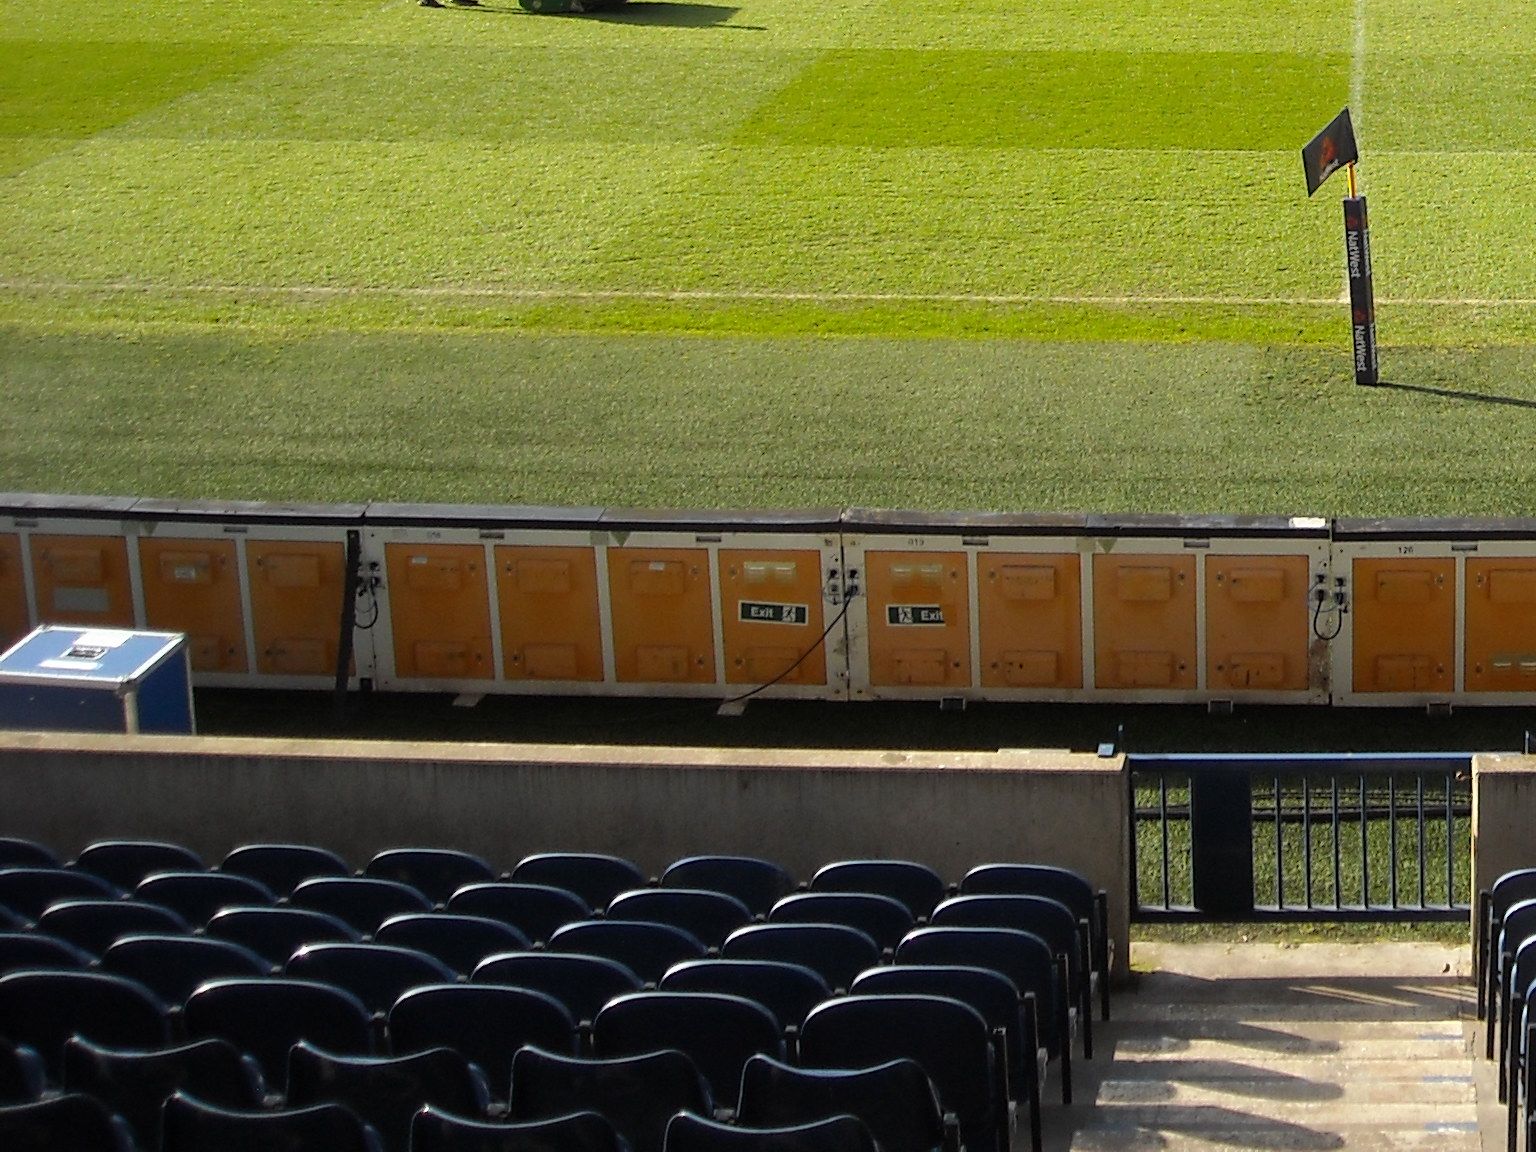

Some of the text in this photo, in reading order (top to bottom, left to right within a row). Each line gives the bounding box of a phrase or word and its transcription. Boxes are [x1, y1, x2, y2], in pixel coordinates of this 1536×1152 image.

[1348, 231, 1362, 278] NatWest
[1355, 325, 1367, 372] NatWest
[751, 606, 774, 619] Exit
[921, 609, 945, 622] Exit
